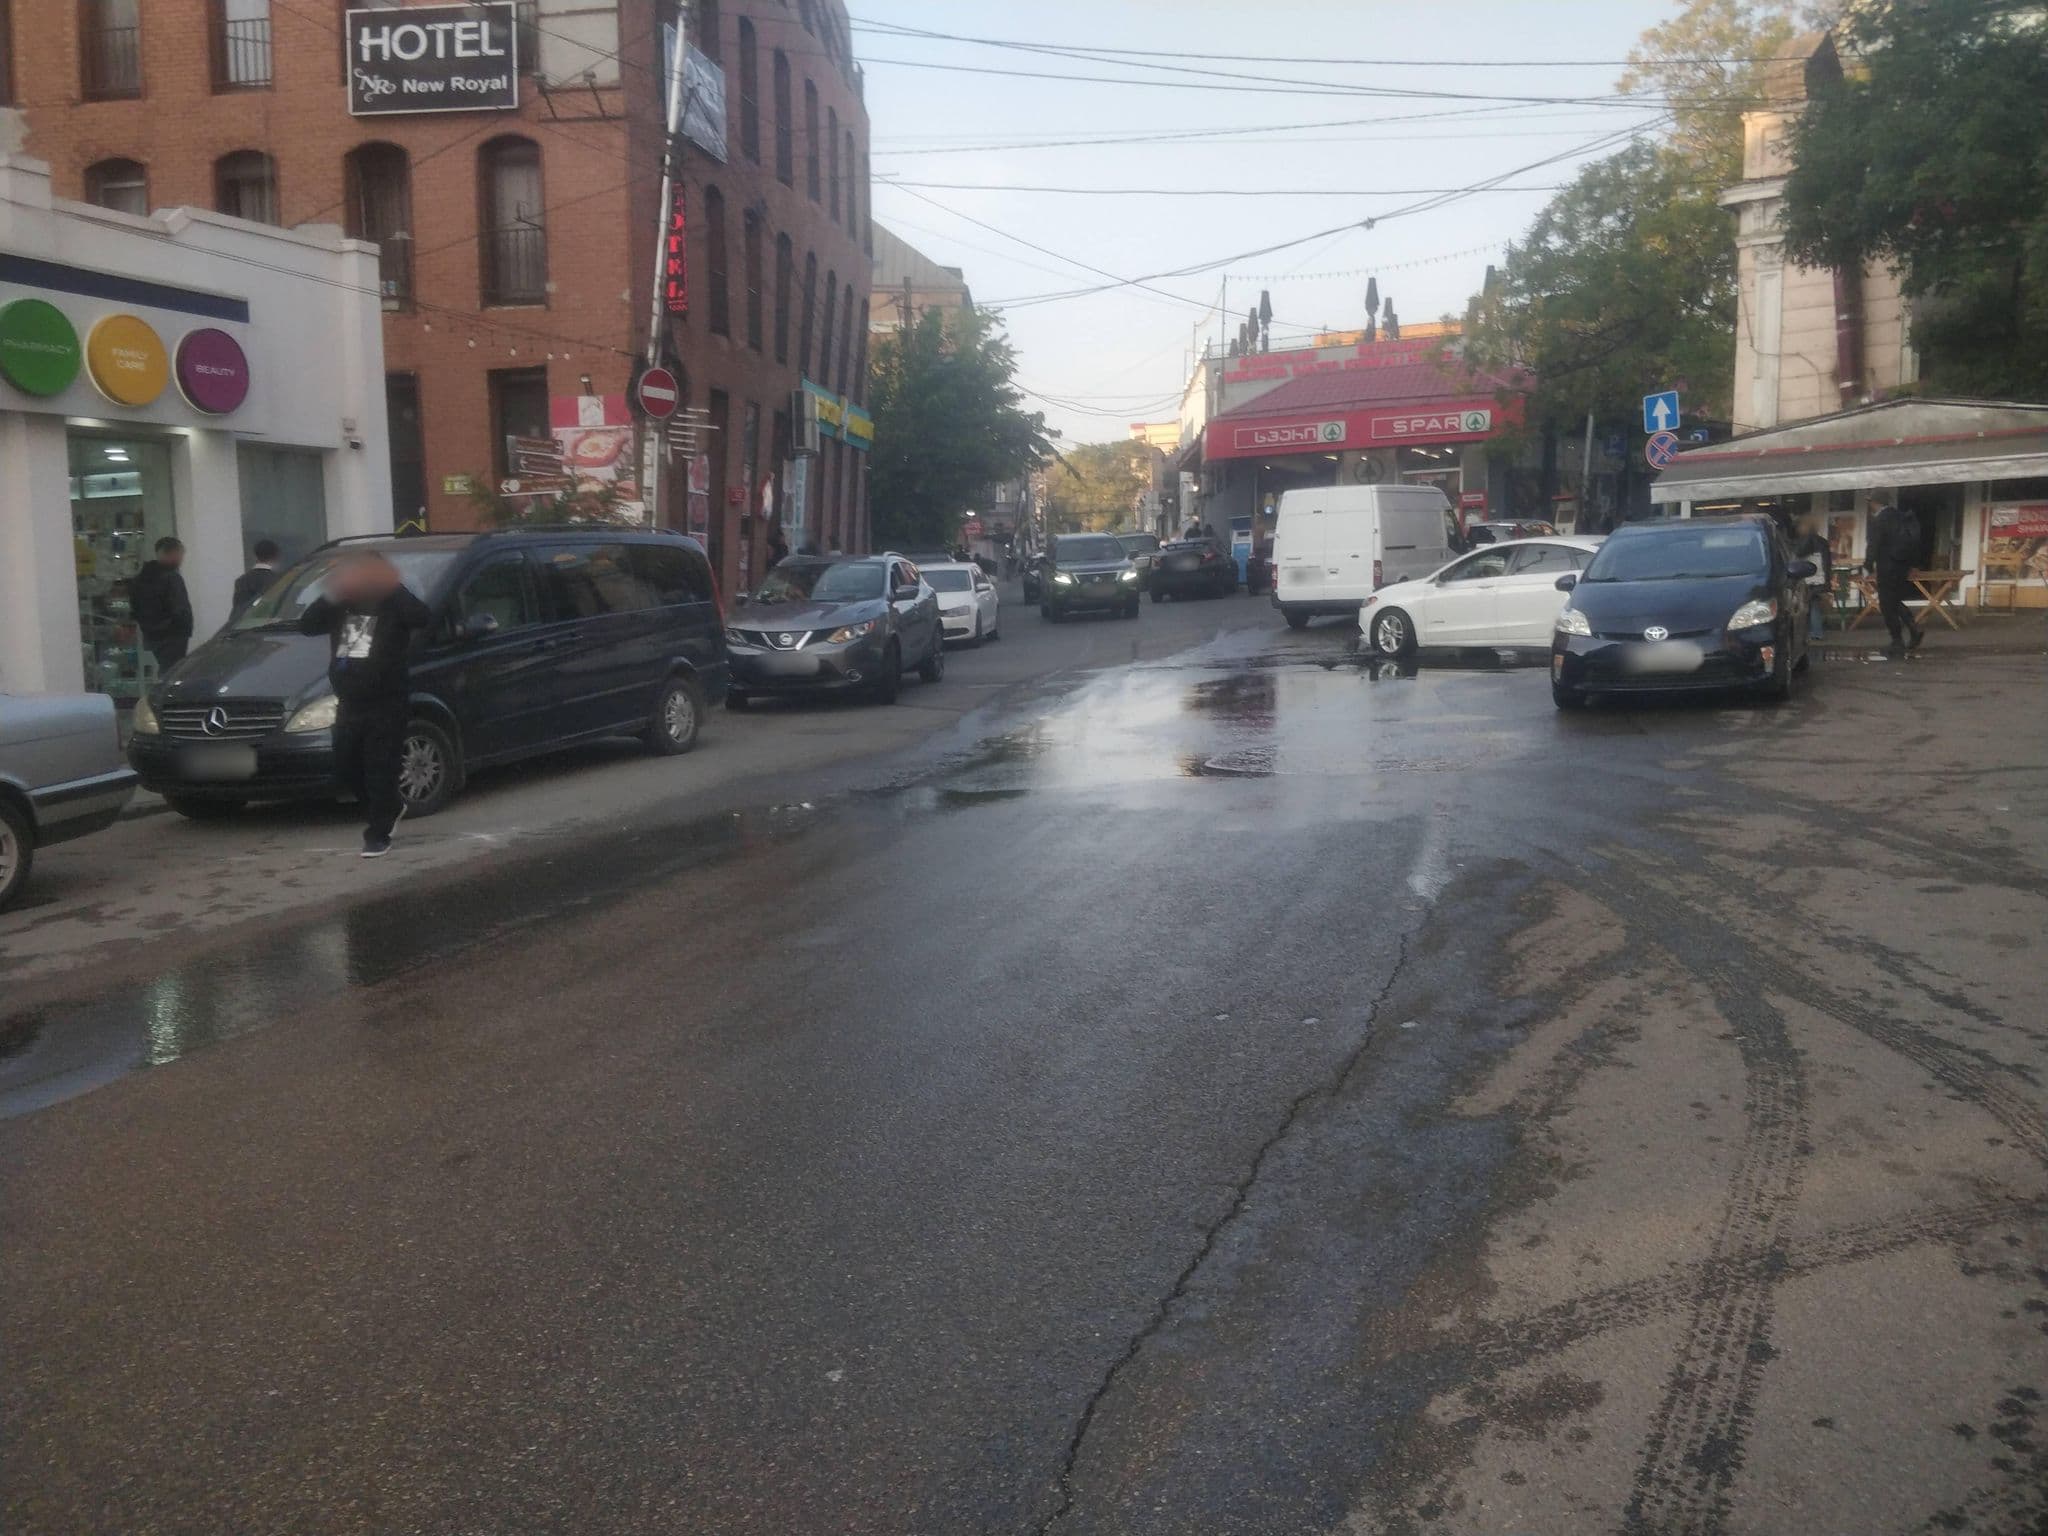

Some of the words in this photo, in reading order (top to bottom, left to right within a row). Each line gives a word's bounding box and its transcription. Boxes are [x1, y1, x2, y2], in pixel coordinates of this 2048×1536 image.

[360, 20, 505, 62] HOTEL
[402, 78, 445, 94] New
[451, 75, 508, 94] Royal
[195, 364, 235, 377] BEAUTY
[1392, 416, 1460, 434] SPAR
